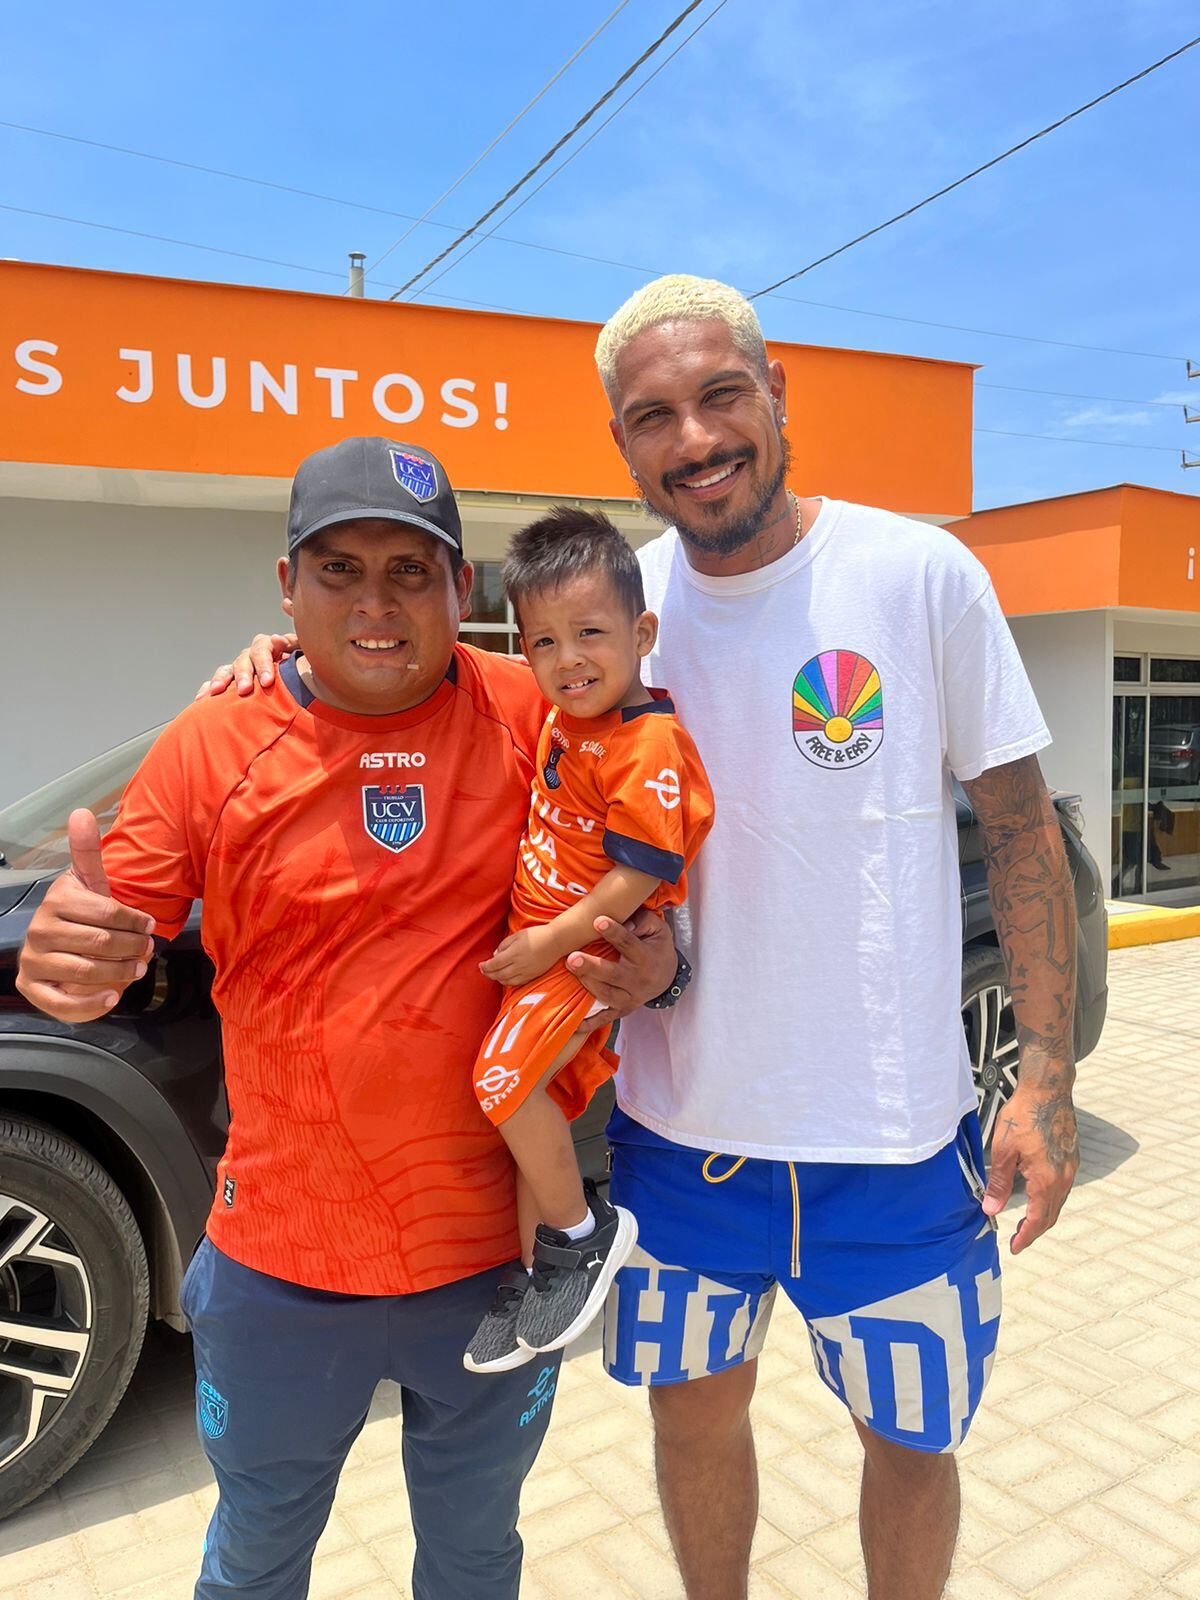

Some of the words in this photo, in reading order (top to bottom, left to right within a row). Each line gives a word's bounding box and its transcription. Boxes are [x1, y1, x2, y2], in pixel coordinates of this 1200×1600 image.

[115, 347, 510, 431] JUNTOS!
[398, 462, 432, 482] UCV
[359, 751, 427, 769] ASTRO
[805, 735, 835, 762] FREE
[833, 749, 846, 763] &
[844, 732, 873, 761] EASY
[370, 800, 417, 819] UCV
[483, 991, 548, 1060] 17
[519, 1382, 556, 1427] ASTRO
